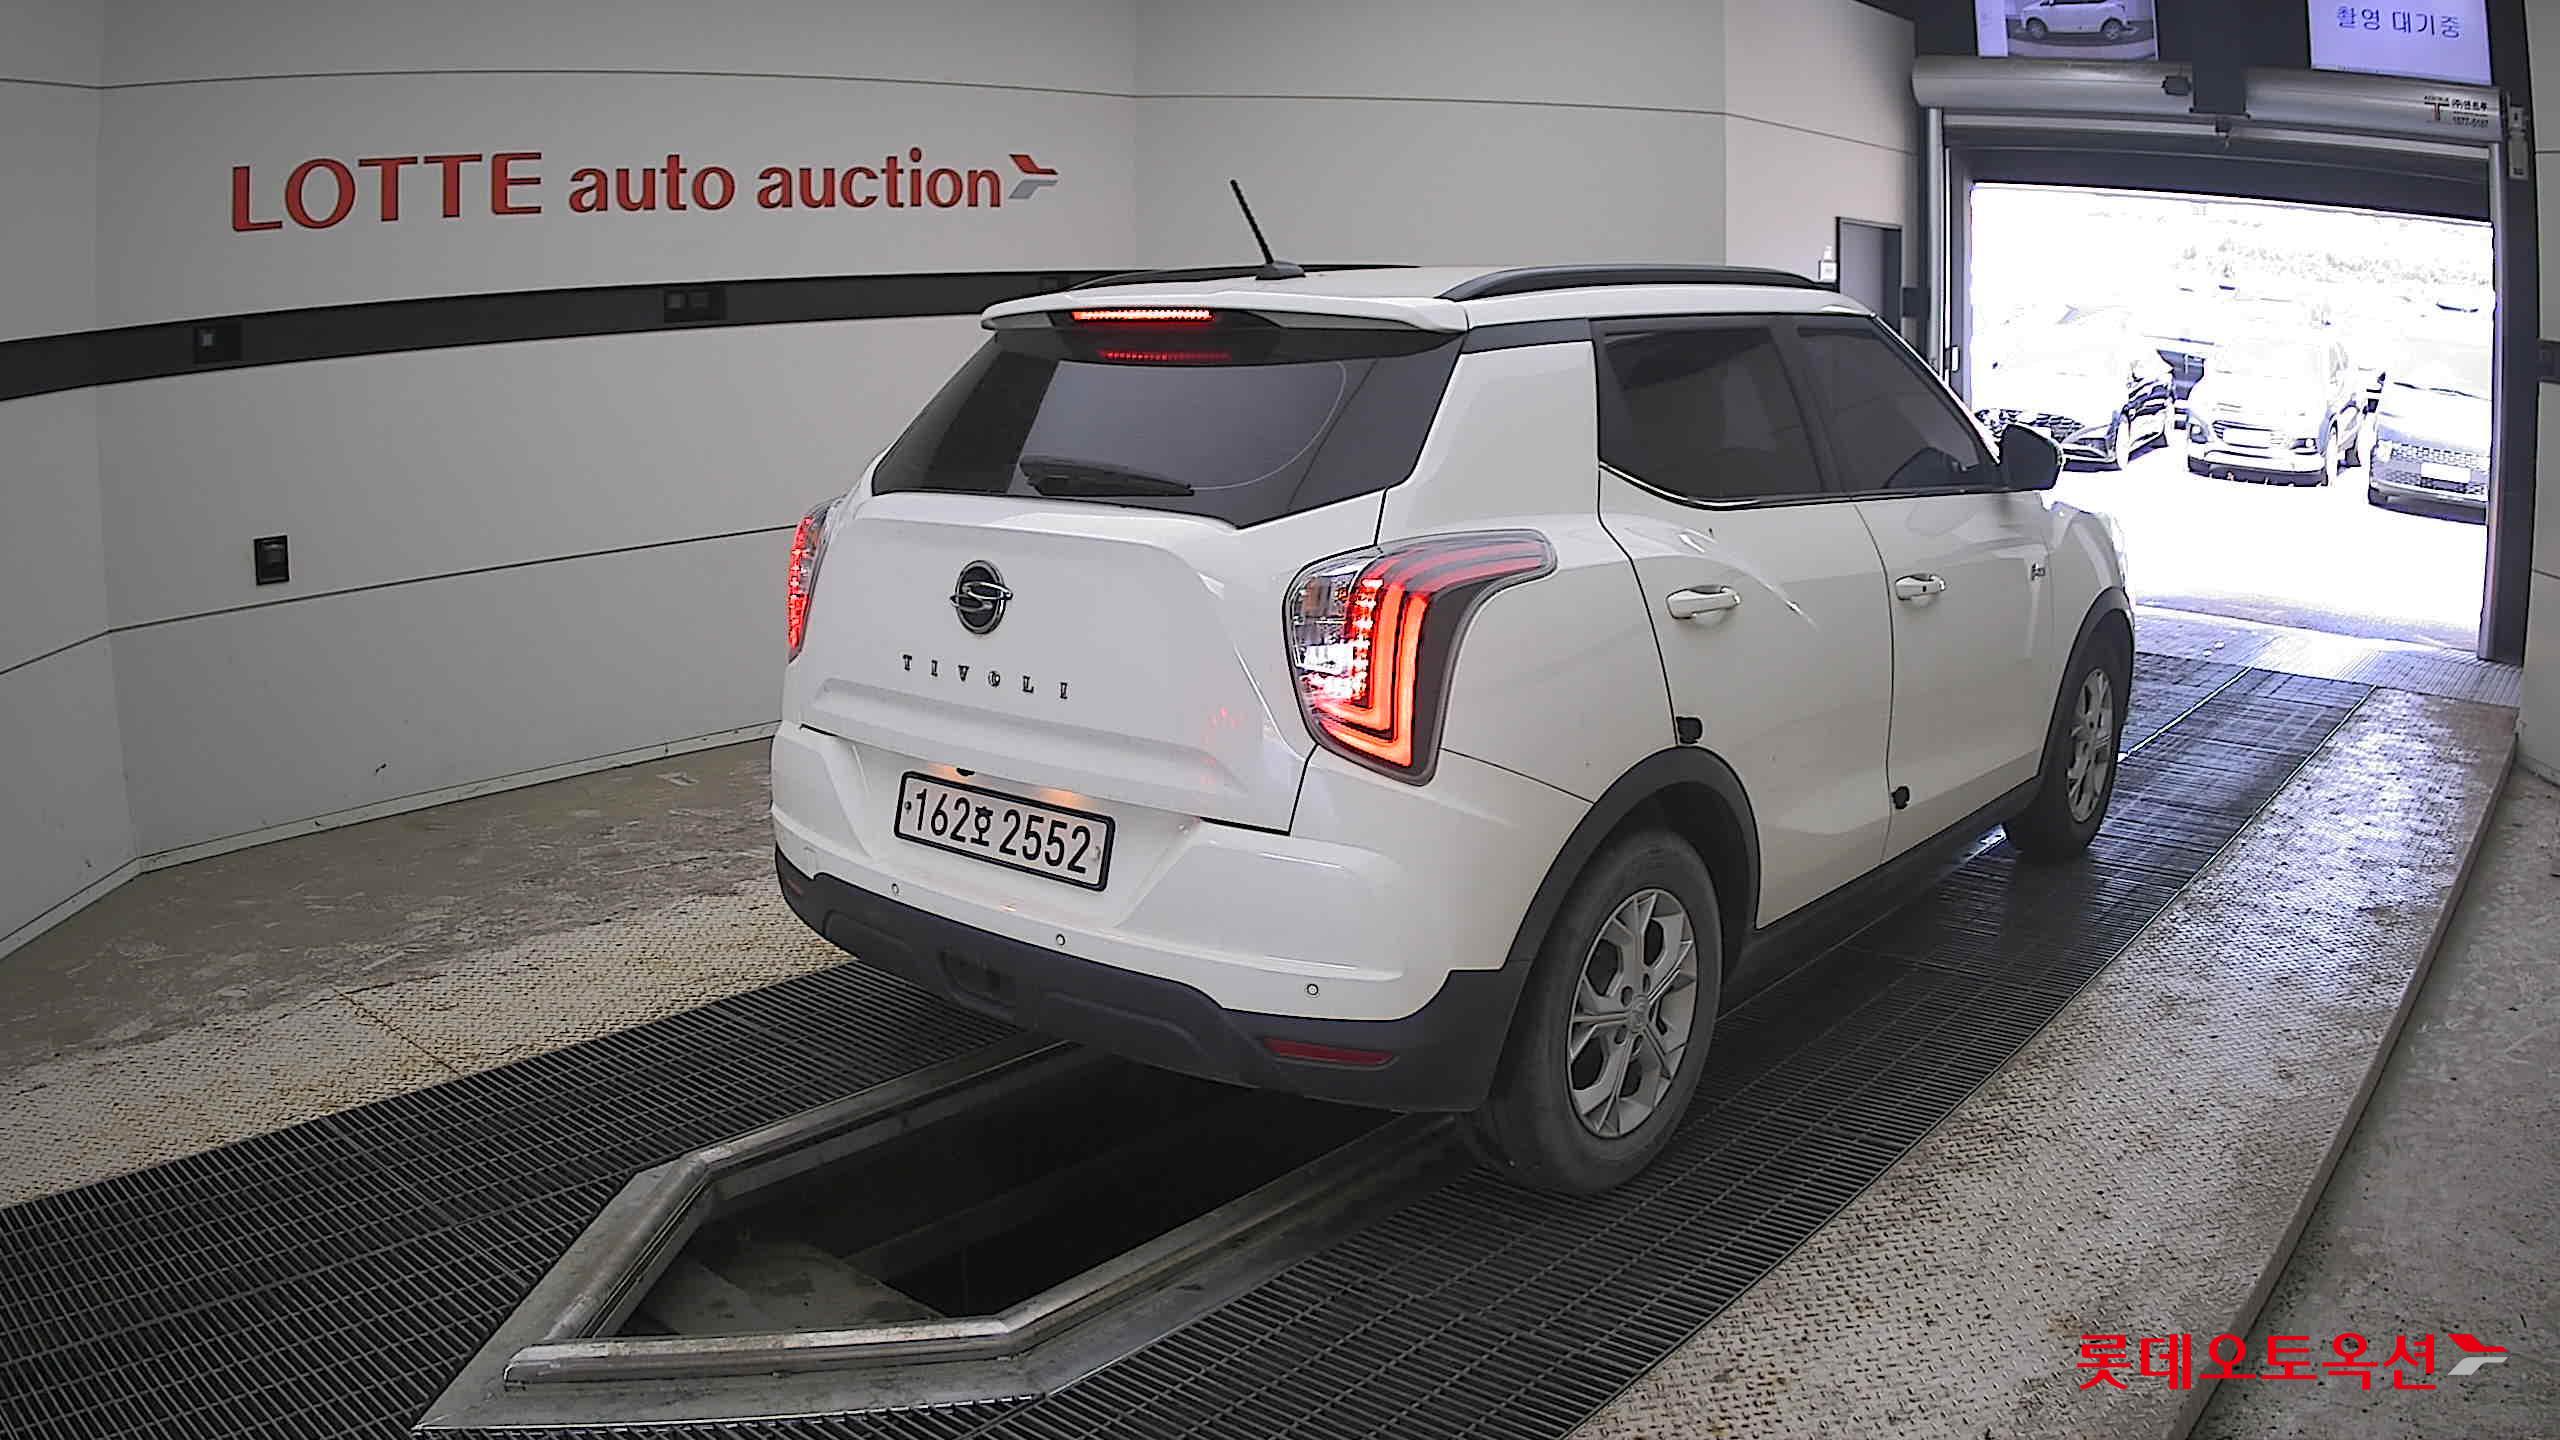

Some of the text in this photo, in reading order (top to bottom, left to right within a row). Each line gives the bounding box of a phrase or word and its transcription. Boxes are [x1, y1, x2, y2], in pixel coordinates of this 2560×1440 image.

[2391, 10, 2460, 39] 대기중
[232, 147, 1003, 232] LOTTE auto auction
[902, 654, 1069, 700] TIVOLI
[999, 808, 1092, 875] 2552
